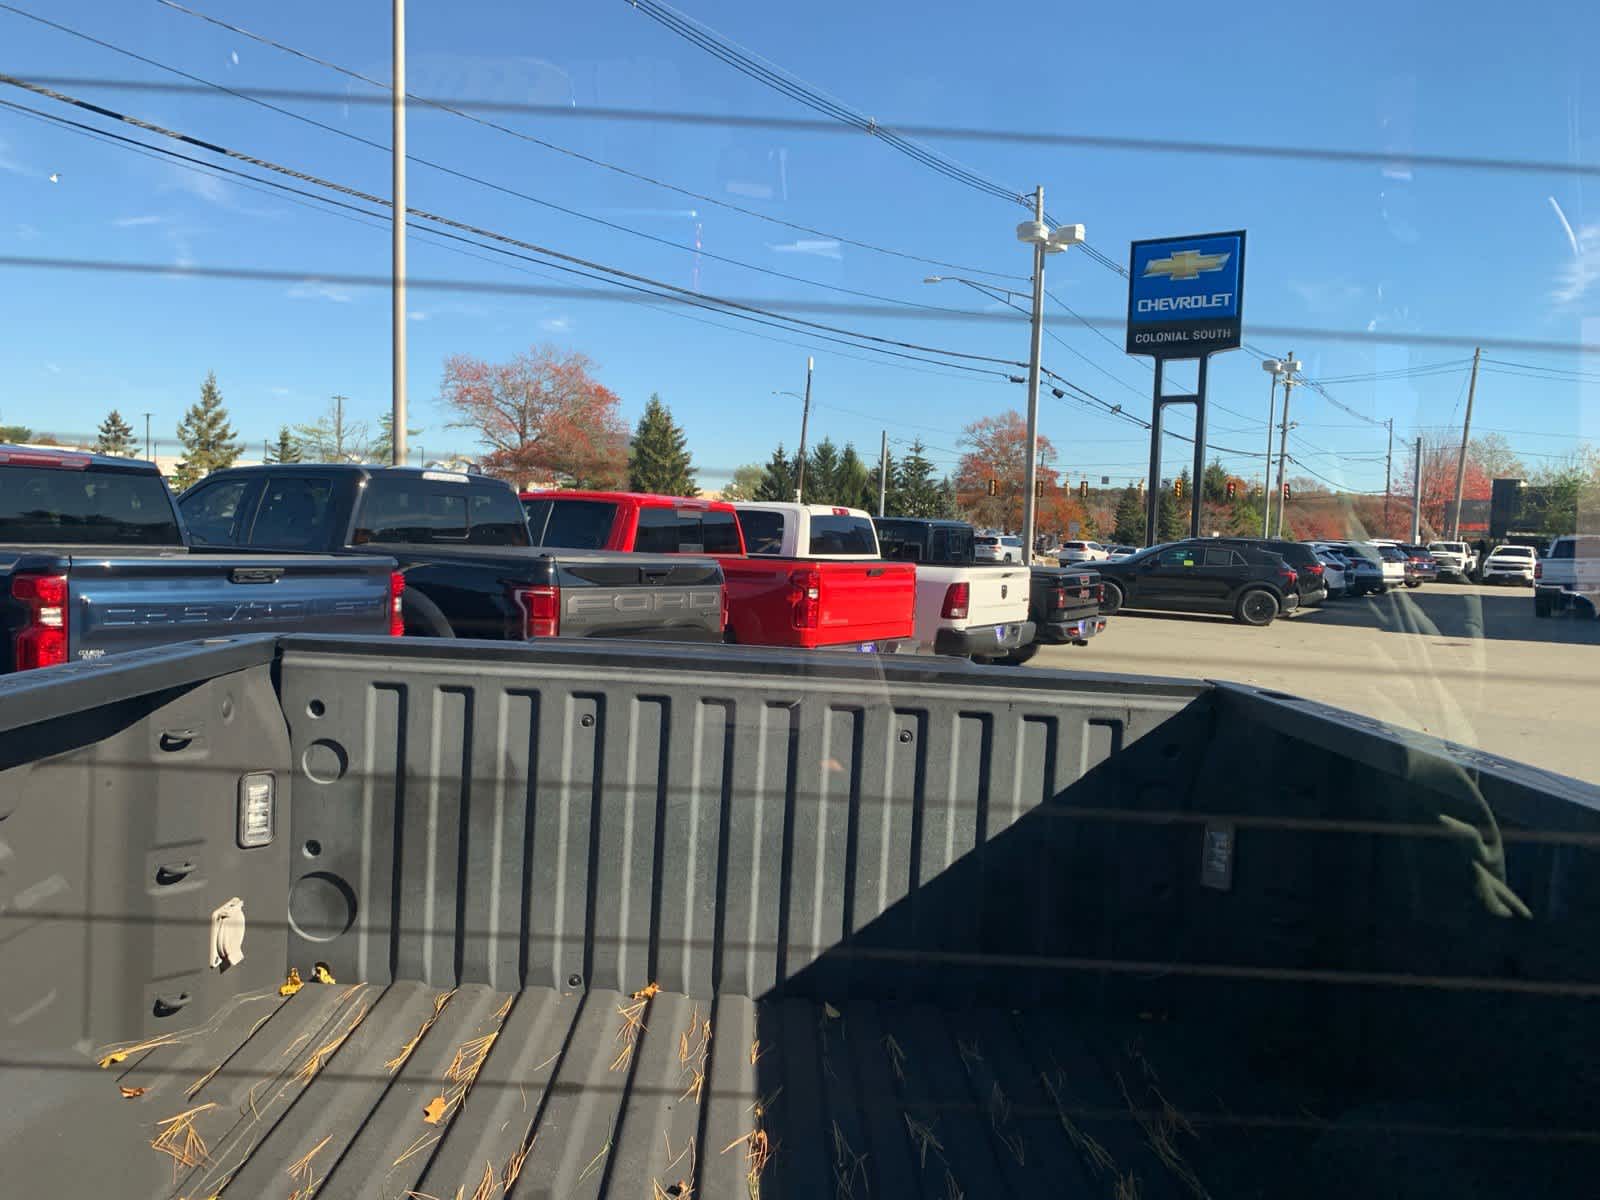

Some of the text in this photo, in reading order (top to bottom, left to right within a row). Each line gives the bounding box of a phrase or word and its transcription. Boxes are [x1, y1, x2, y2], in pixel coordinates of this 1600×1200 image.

[1138, 293, 1232, 312] CHEVROLET
[1135, 328, 1231, 344] COLONIAL SOUTH
[568, 591, 720, 613] FORD
